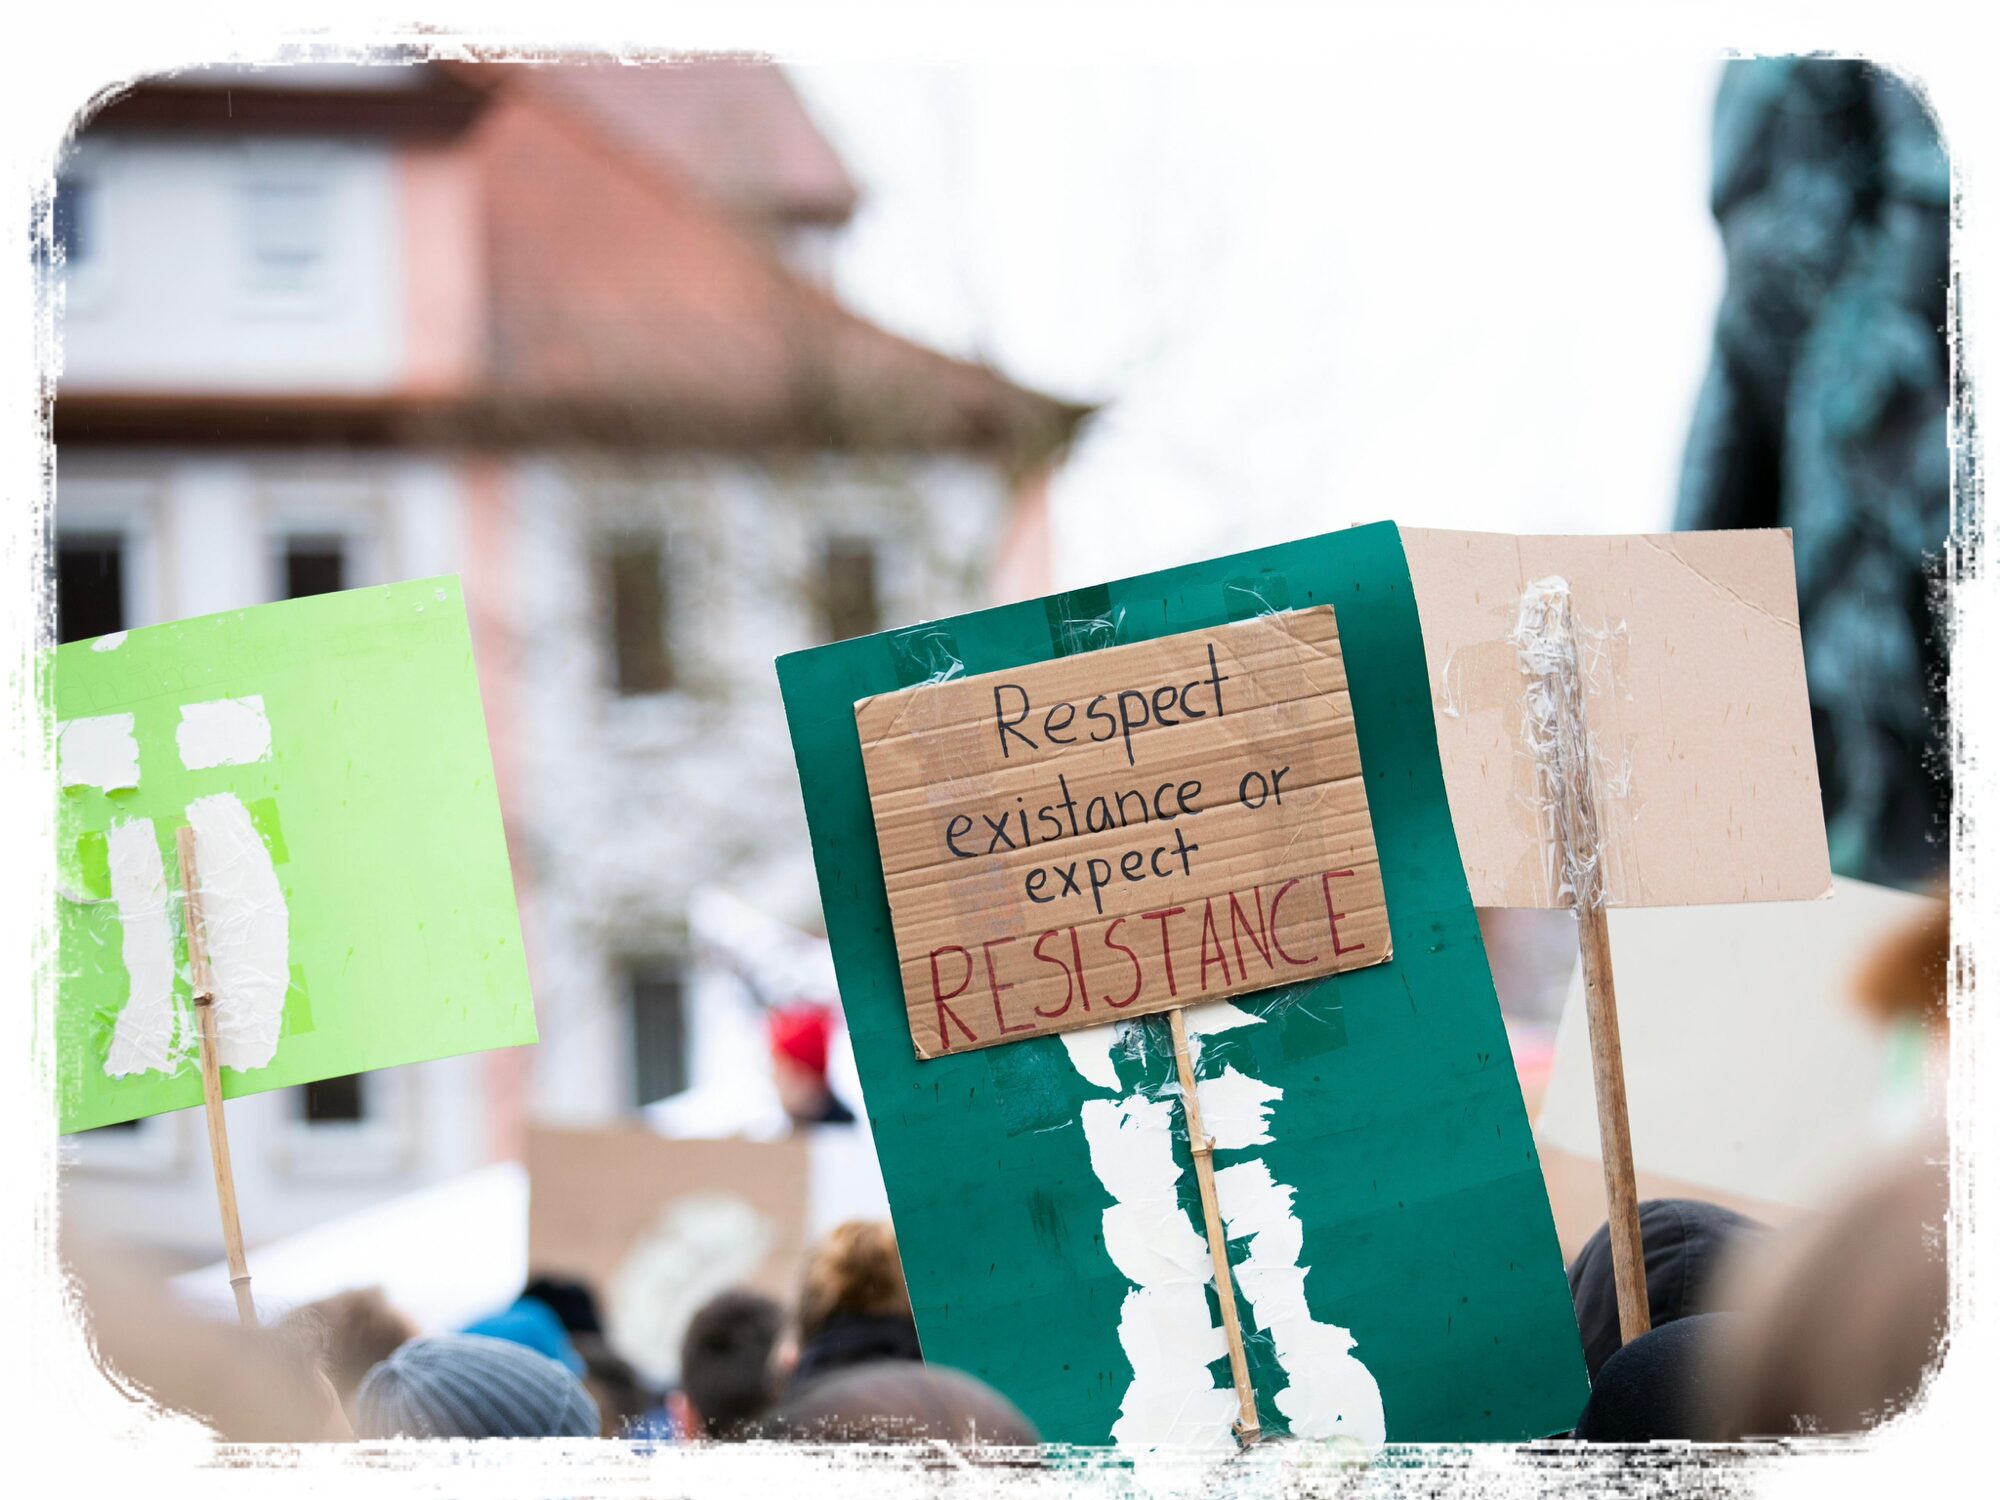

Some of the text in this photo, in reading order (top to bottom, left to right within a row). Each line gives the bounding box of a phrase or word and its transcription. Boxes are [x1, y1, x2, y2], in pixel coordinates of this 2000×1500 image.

[993, 643, 1229, 766] Respect
[945, 766, 1291, 858] existance or
[1025, 828, 1199, 915] expect
[930, 869, 1366, 1050] RESISTANCE
